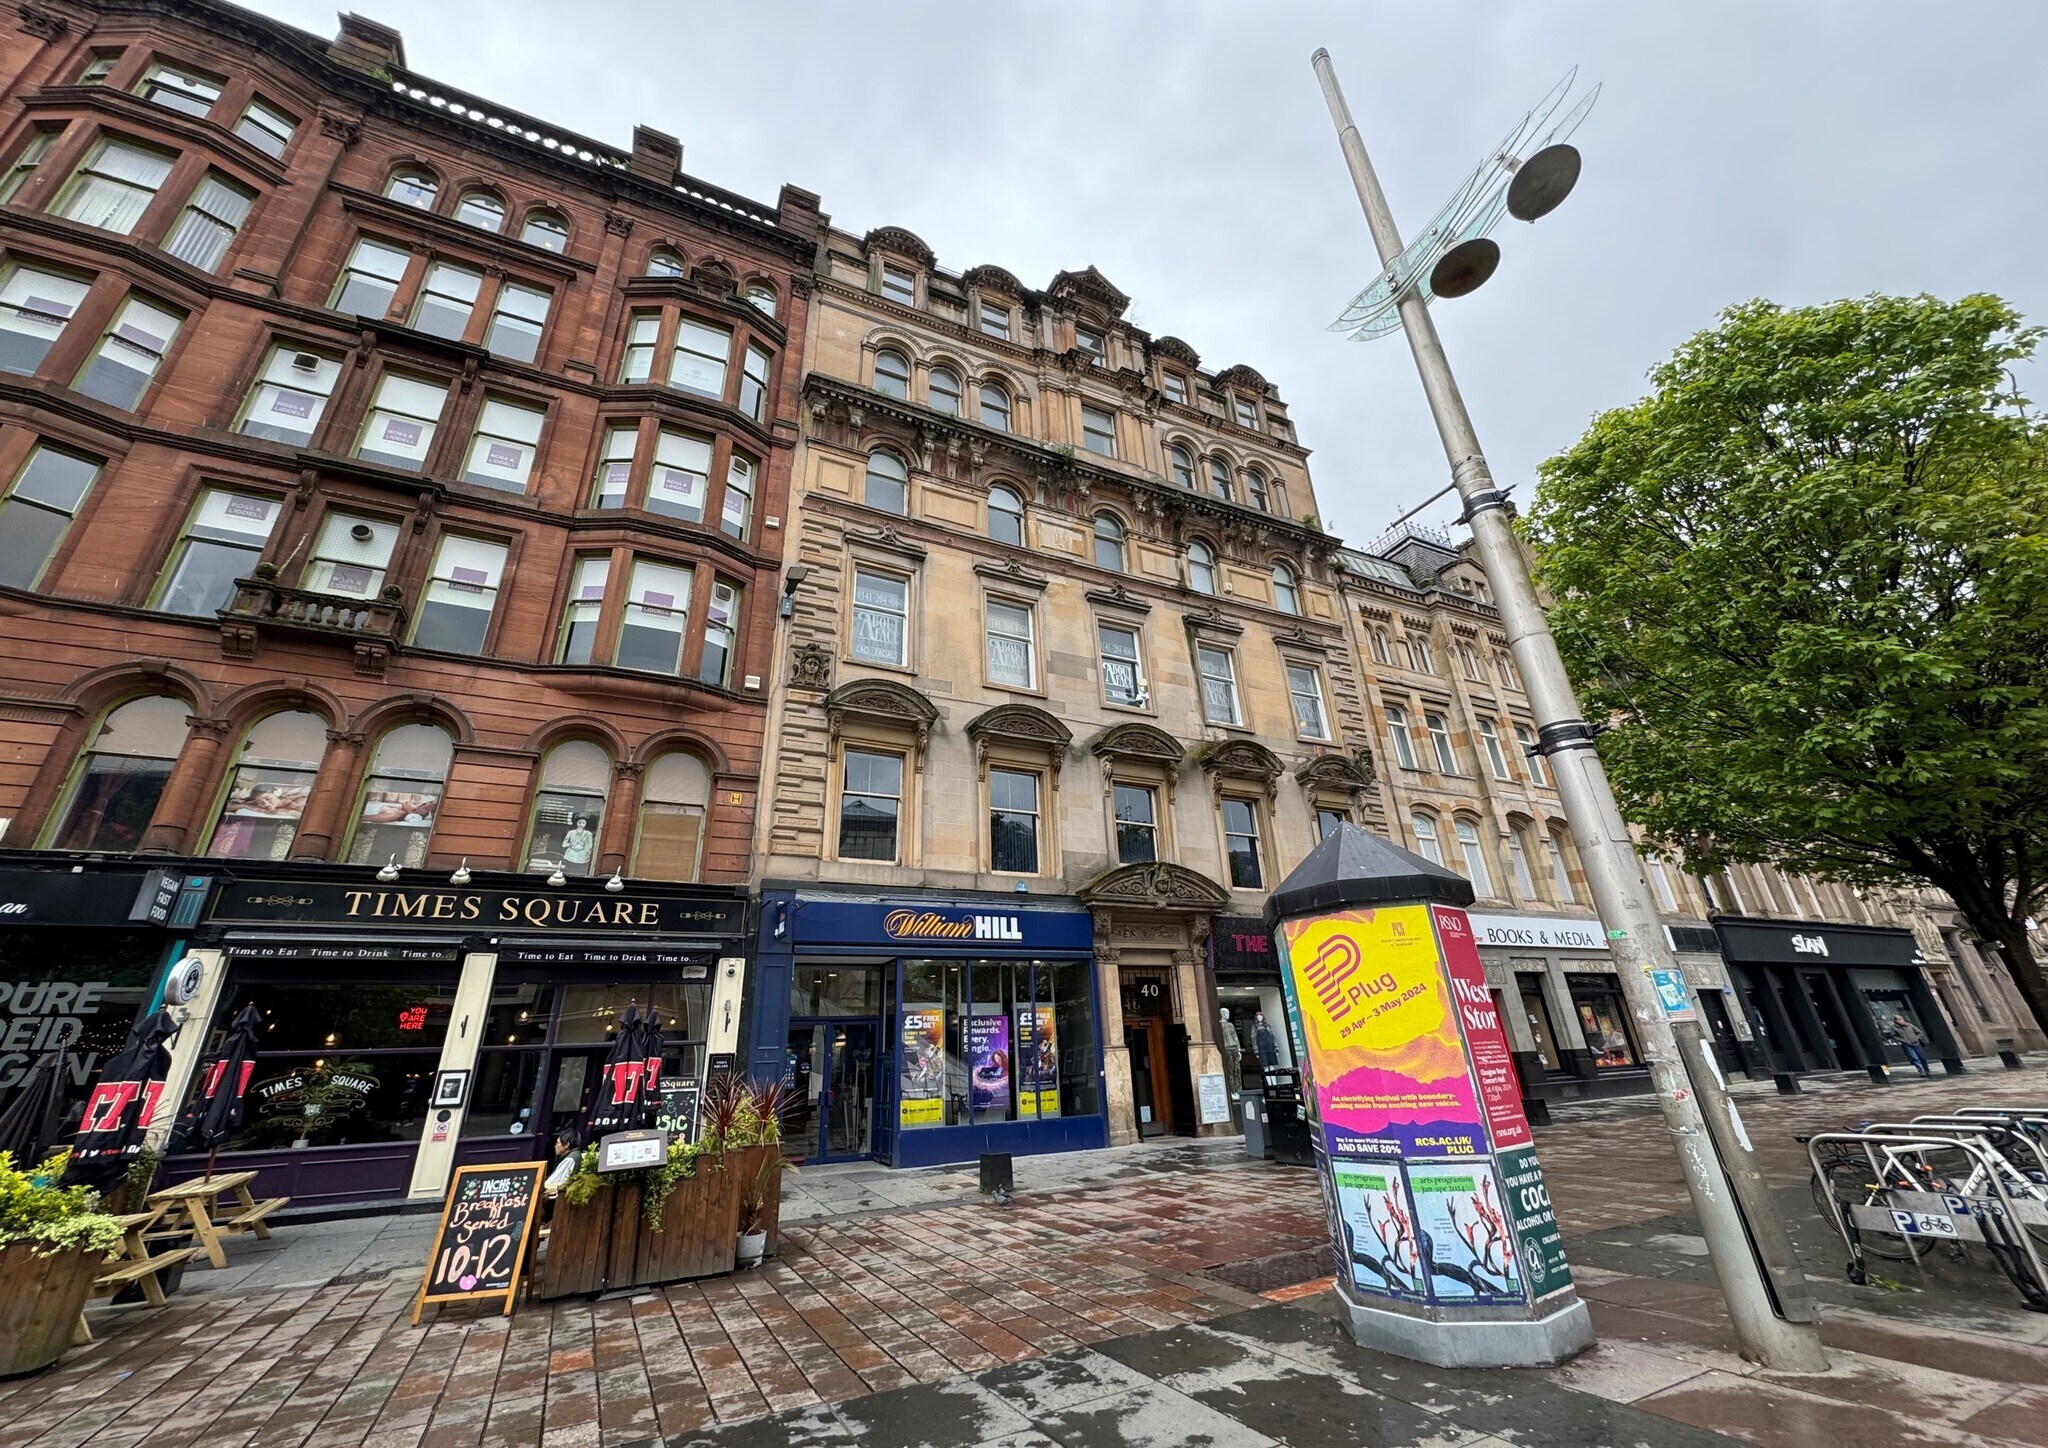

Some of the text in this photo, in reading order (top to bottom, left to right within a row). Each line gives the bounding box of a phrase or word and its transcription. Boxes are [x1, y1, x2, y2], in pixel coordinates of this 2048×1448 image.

[274, 406, 306, 417] LIDDELL
[276, 401, 298, 411] ROSS
[385, 434, 415, 445] LIDDELL
[387, 429, 407, 438] ROSS
[488, 458, 516, 468] LIDDELL
[490, 453, 508, 461] ROSS
[231, 502, 255, 511] ROSS
[228, 508, 263, 519] LIDDELL
[161, 875, 180, 892] VEGAN
[157, 892, 172, 905] FAST
[151, 906, 167, 921] FOOD
[344, 891, 660, 927] TIMES SQUARE
[883, 908, 1023, 940] William HILL
[1231, 934, 1268, 953] THE
[1487, 928, 1533, 945] BOOKS
[1540, 931, 1549, 945] &
[1554, 931, 1595, 946] MEDIA
[228, 946, 257, 956] Time
[261, 947, 274, 956] to
[278, 947, 298, 956] Eat
[311, 948, 339, 957] Time
[343, 949, 354, 957] to
[358, 949, 390, 958] Drink
[402, 950, 429, 959] Time
[518, 951, 542, 960] Time
[545, 952, 555, 960] to
[558, 952, 574, 961] Eat
[584, 952, 606, 962] Time
[609, 953, 619, 961] to
[621, 953, 648, 962] Drink
[656, 954, 678, 962] Time
[1141, 984, 1159, 997] 40
[1347, 972, 1398, 1006] Plug
[1453, 978, 1492, 1003] West
[1340, 983, 1427, 1039] 29 Apr 3 May 2024
[399, 1022, 424, 1030] HERE
[904, 1015, 923, 1029] £5
[259, 1074, 374, 1098] TIMES SQUARE
[1375, 1094, 1400, 1102] festival
[1400, 1093, 1418, 1101] with
[1418, 1093, 1456, 1101] boundary-
[1388, 1101, 1418, 1109] exciting
[1415, 1136, 1472, 1147] RCS.AC.UK/
[1338, 1143, 1402, 1154] AND SAVE 20%
[1447, 1145, 1474, 1154] PLUG
[1519, 1159, 1528, 1169] DO
[1354, 1175, 1386, 1183] programme
[1434, 1177, 1474, 1187] programme
[1505, 1177, 1518, 1188] YOU
[1518, 1173, 1534, 1184] HAVE
[1421, 1185, 1446, 1194] jan-apr
[450, 1193, 528, 1228] Breakfast
[1943, 1195, 1963, 1214] P
[1516, 1214, 1542, 1231] ALCOHOL
[1891, 1211, 1907, 1231] P
[435, 1234, 511, 1284] 10-12
